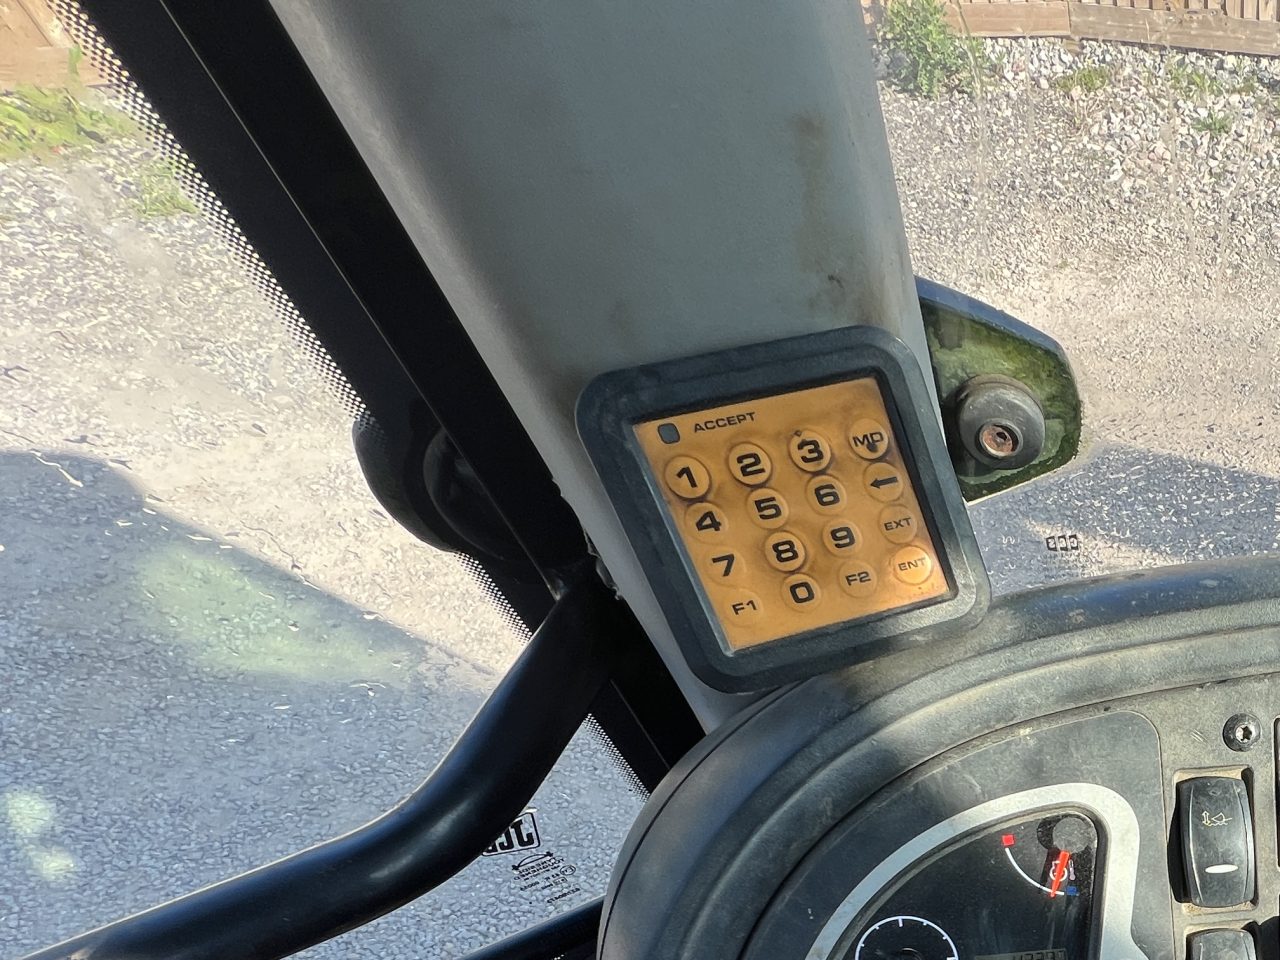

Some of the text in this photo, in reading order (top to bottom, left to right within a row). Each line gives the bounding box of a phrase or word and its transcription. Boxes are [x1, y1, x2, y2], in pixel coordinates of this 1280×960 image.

[693, 411, 756, 434] ACCEPT
[676, 466, 698, 488] 1
[736, 454, 765, 477] 2
[796, 441, 823, 464] 3
[695, 484, 842, 532] 4 5 6
[711, 515, 913, 577] 7 8 9 EXT
[731, 556, 926, 616] F1 0 F2 ENT
